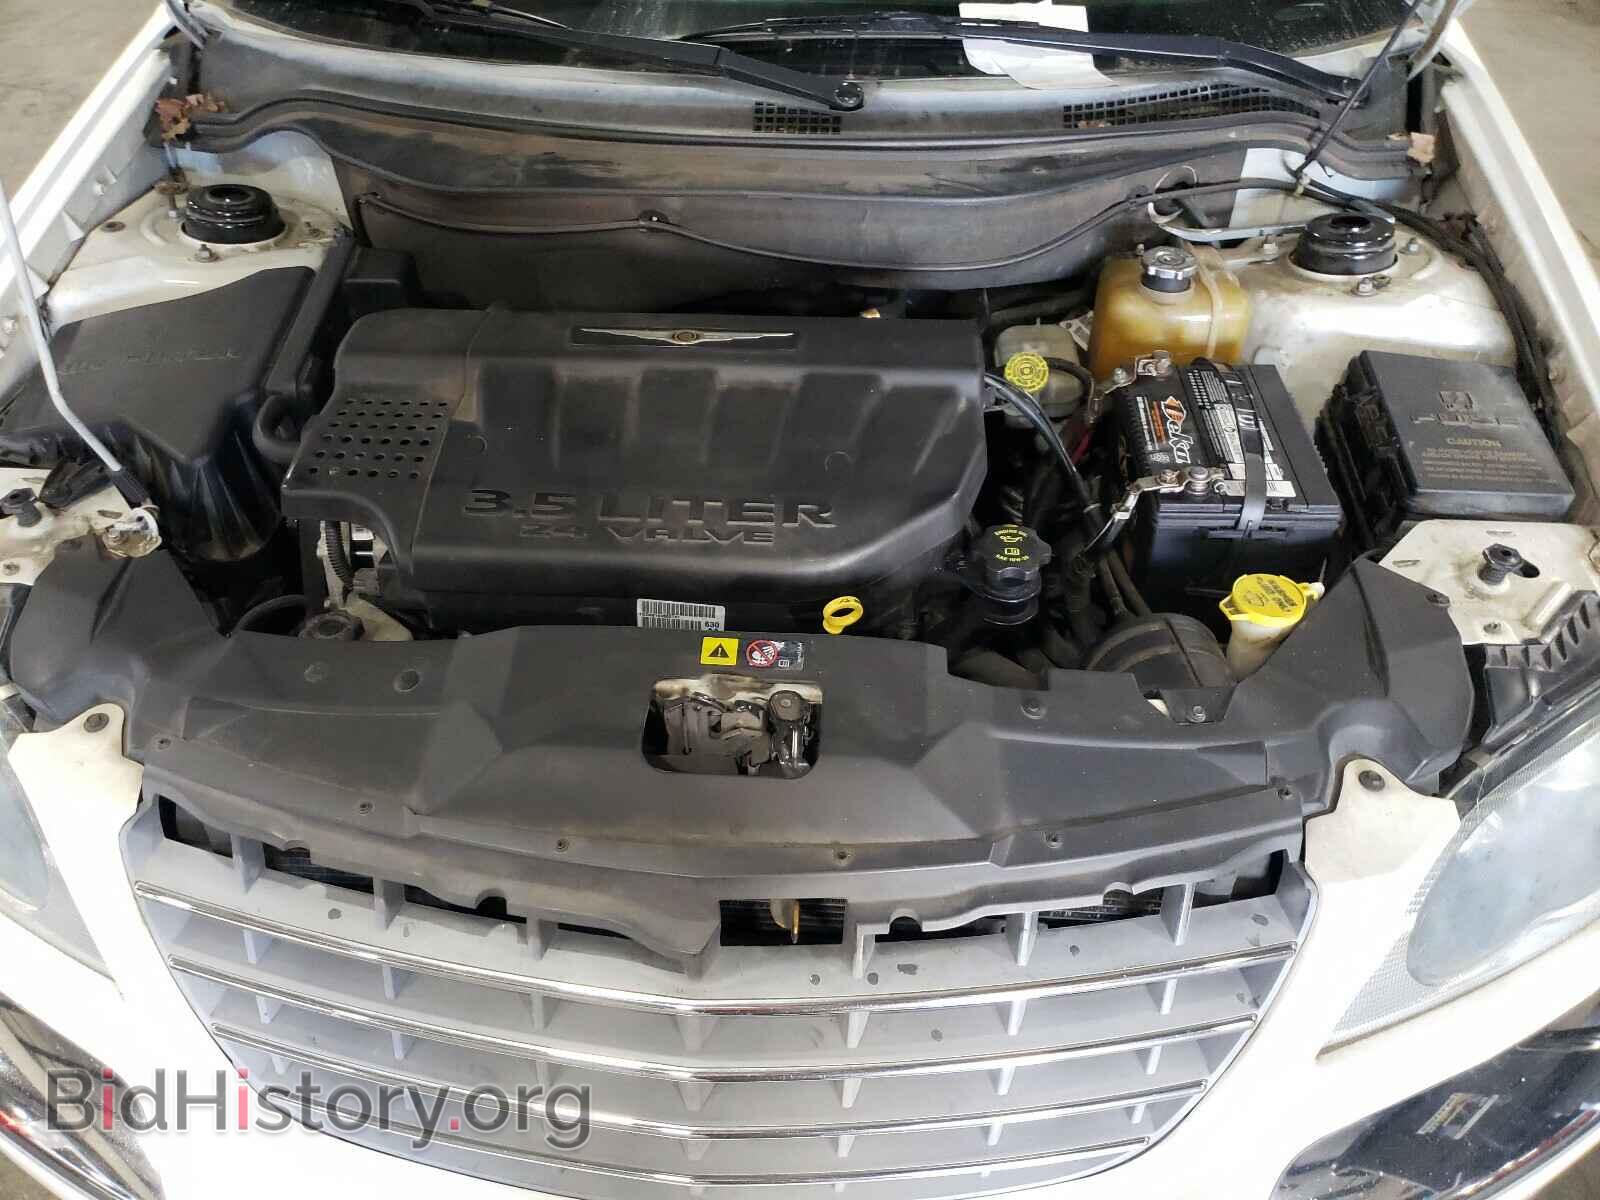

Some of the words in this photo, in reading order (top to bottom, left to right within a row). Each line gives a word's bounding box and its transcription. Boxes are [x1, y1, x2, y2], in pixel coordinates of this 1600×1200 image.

[1160, 396, 1193, 464] Deka
[463, 488, 578, 519] 3.5
[597, 490, 837, 529] LITER
[606, 528, 775, 545] VALVE
